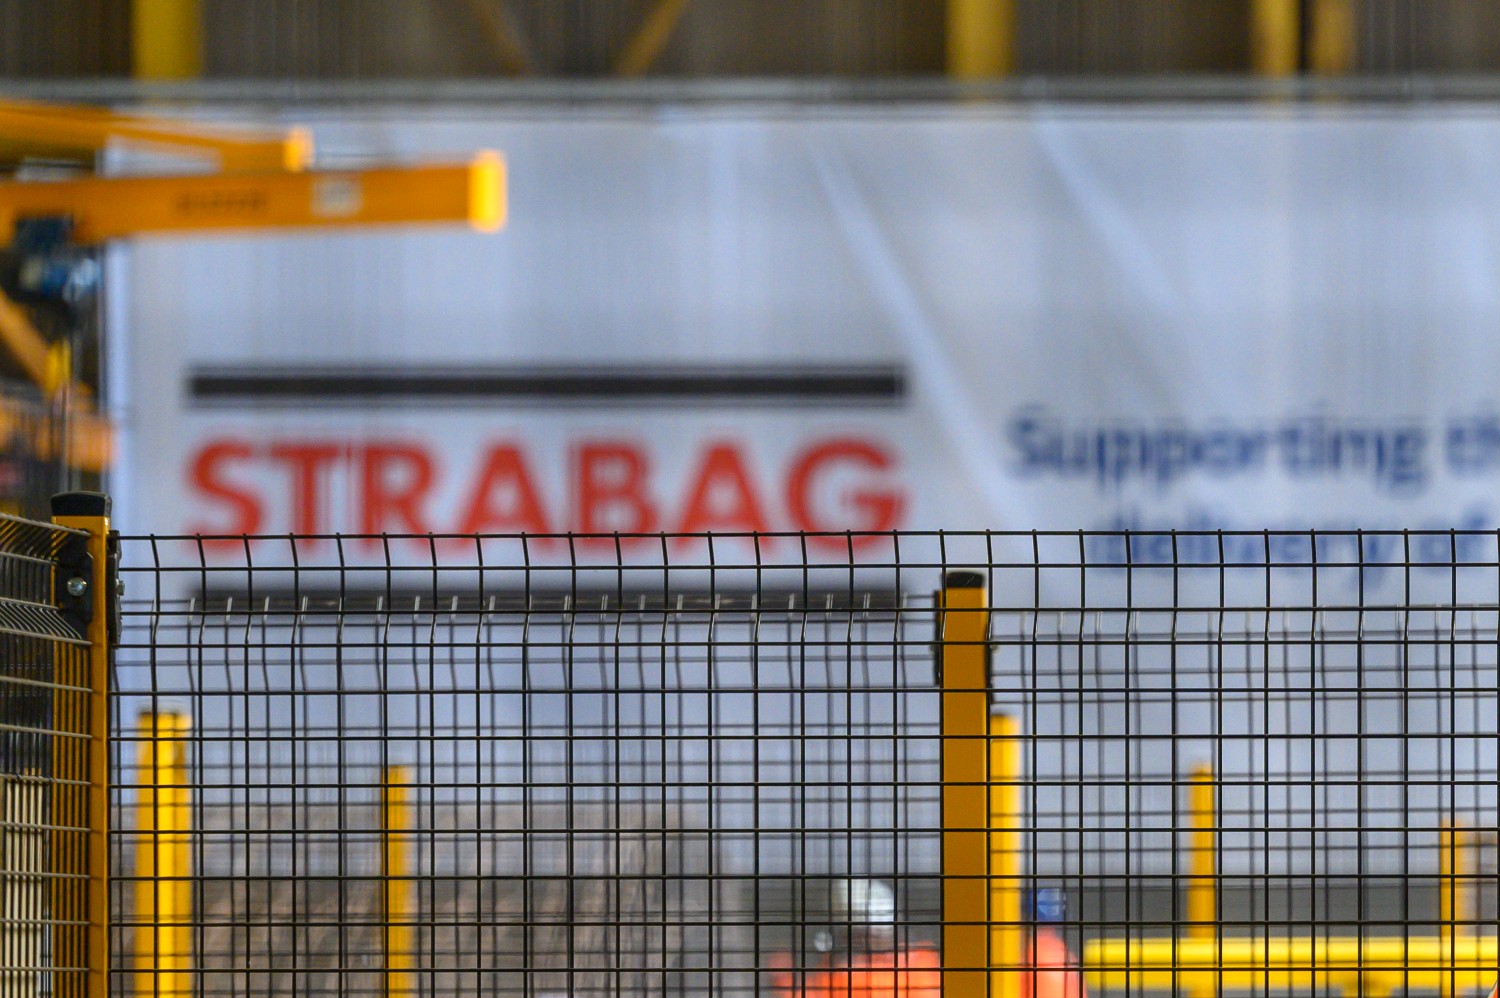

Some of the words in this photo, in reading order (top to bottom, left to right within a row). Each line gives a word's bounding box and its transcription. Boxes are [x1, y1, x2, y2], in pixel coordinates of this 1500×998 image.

[185, 430, 906, 556] STRABAG
[1009, 408, 1428, 495] Supporting
[1416, 503, 1491, 572] of
